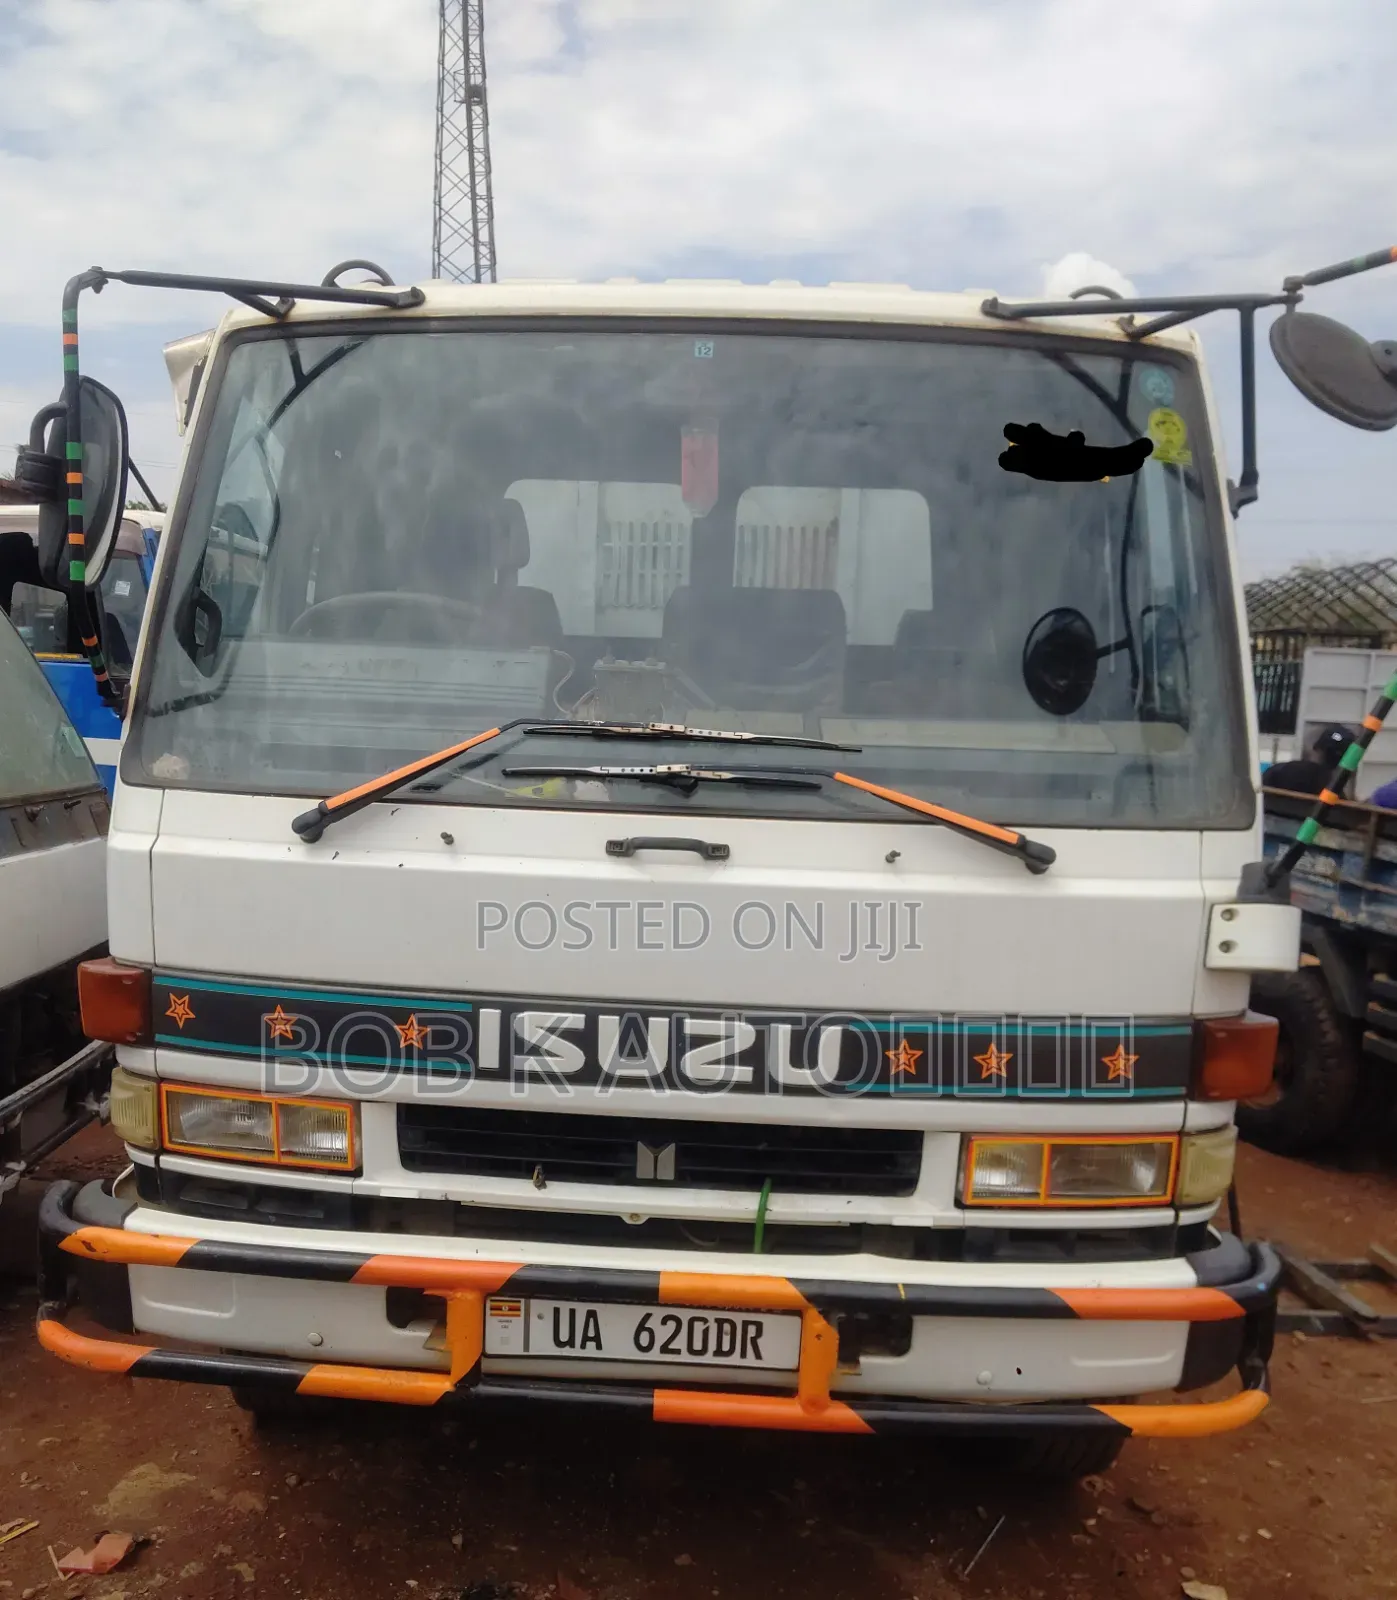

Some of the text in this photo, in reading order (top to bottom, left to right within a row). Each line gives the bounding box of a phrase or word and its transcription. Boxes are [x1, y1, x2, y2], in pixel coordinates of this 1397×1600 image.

[697, 346, 712, 356] 12
[478, 1008, 842, 1086] ISUZU
[552, 1306, 764, 1361] UA 620DR
